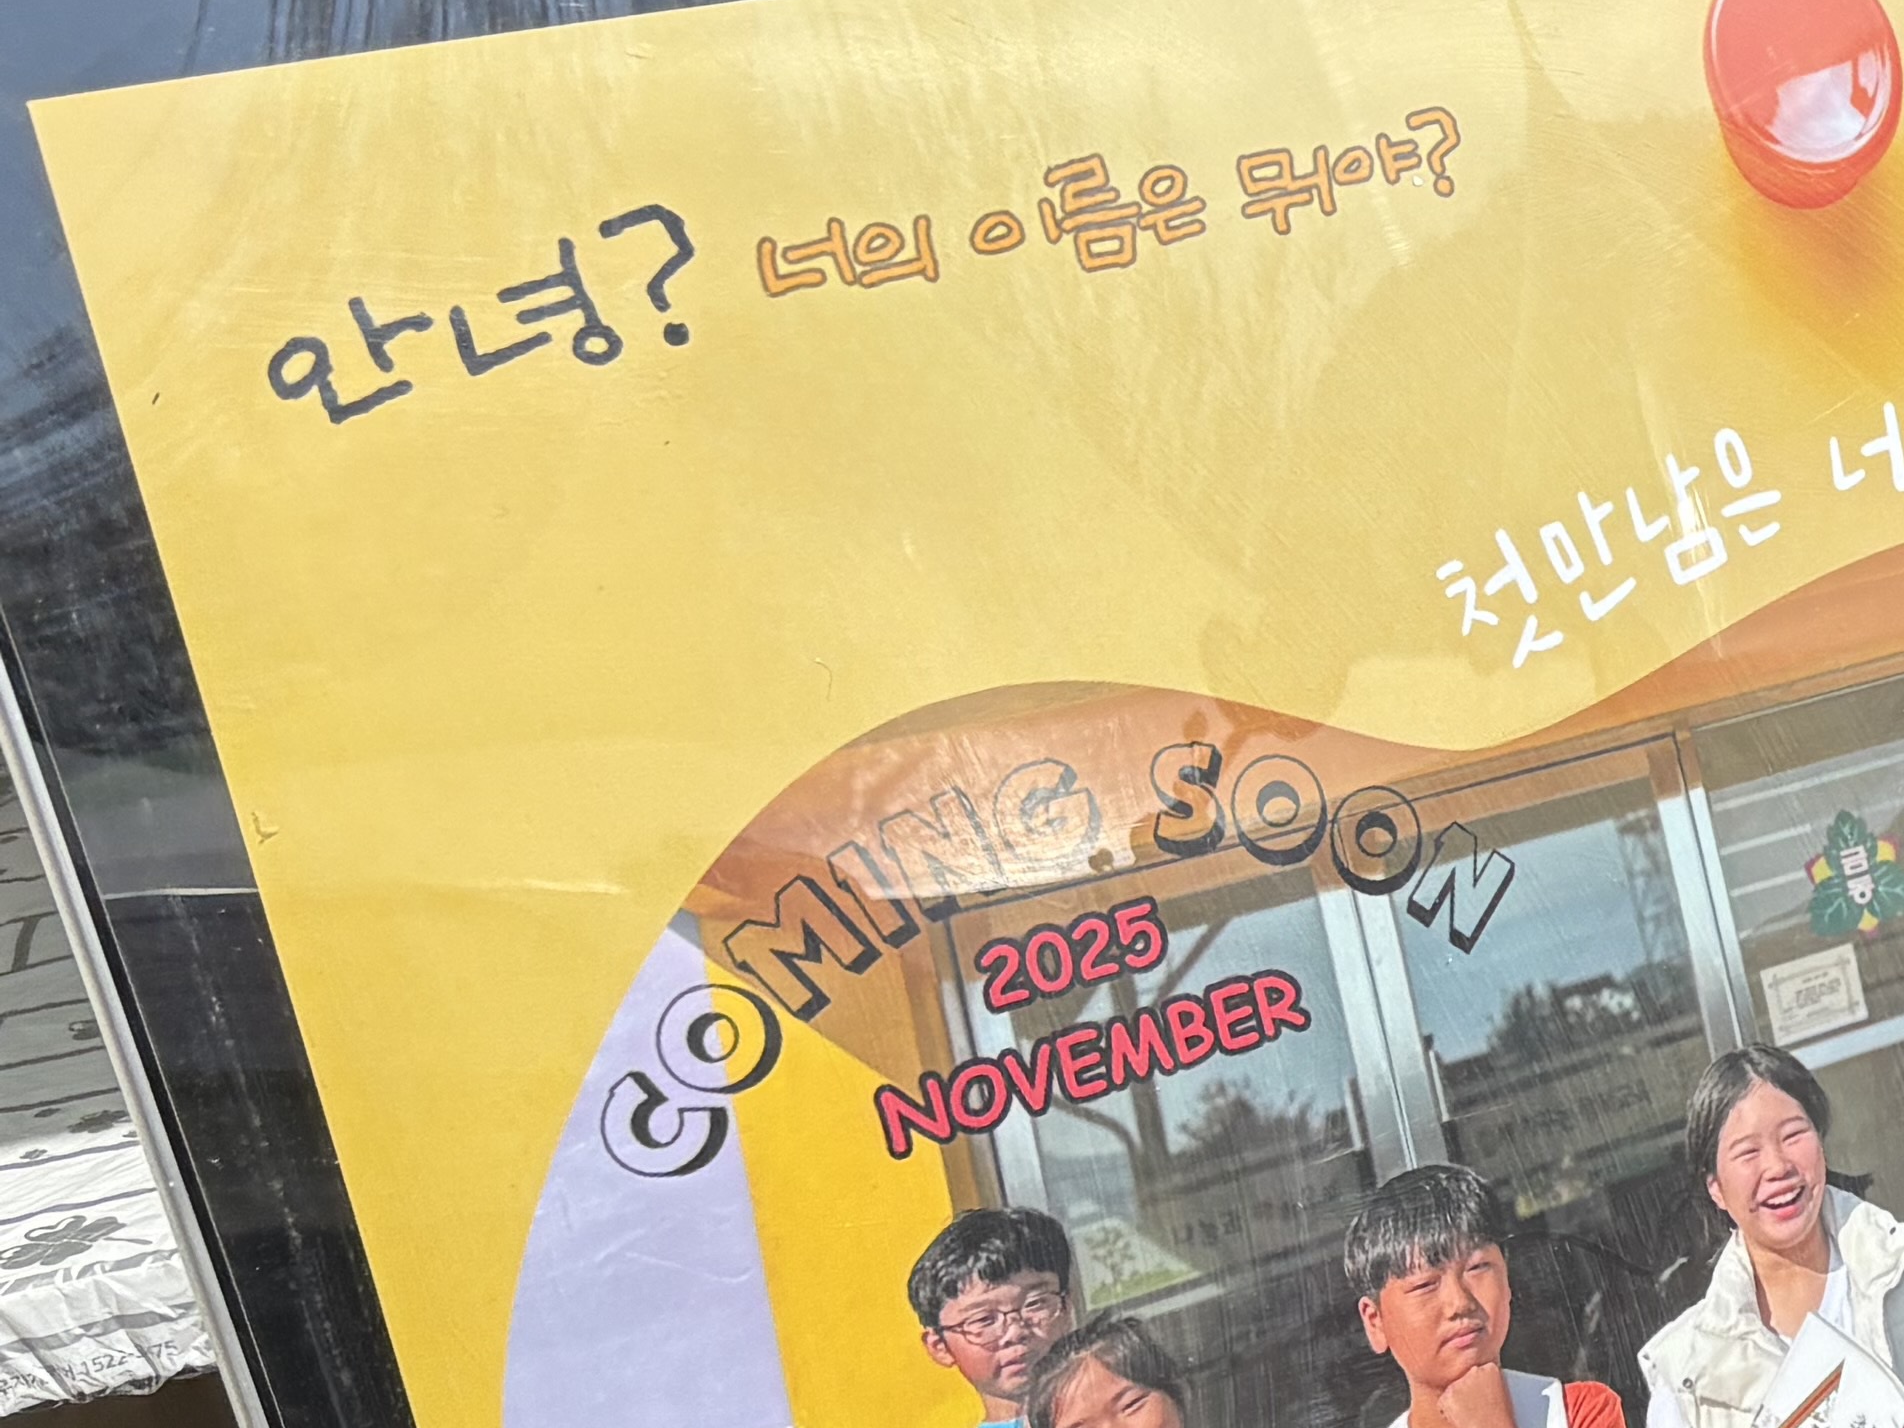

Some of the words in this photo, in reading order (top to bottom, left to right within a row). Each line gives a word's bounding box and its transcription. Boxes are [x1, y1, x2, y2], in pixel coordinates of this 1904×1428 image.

[267, 203, 696, 426] 안녕?
[757, 214, 939, 297] 너의
[970, 152, 1206, 273] 이름은
[1237, 105, 1463, 235] 뭐야?
[1434, 426, 1782, 670] 첫만남은
[600, 757, 1102, 1178] COMING
[1151, 739, 1516, 955] SOON
[876, 969, 1312, 1160] NOVEMBER
[976, 896, 1167, 1013] 2025
